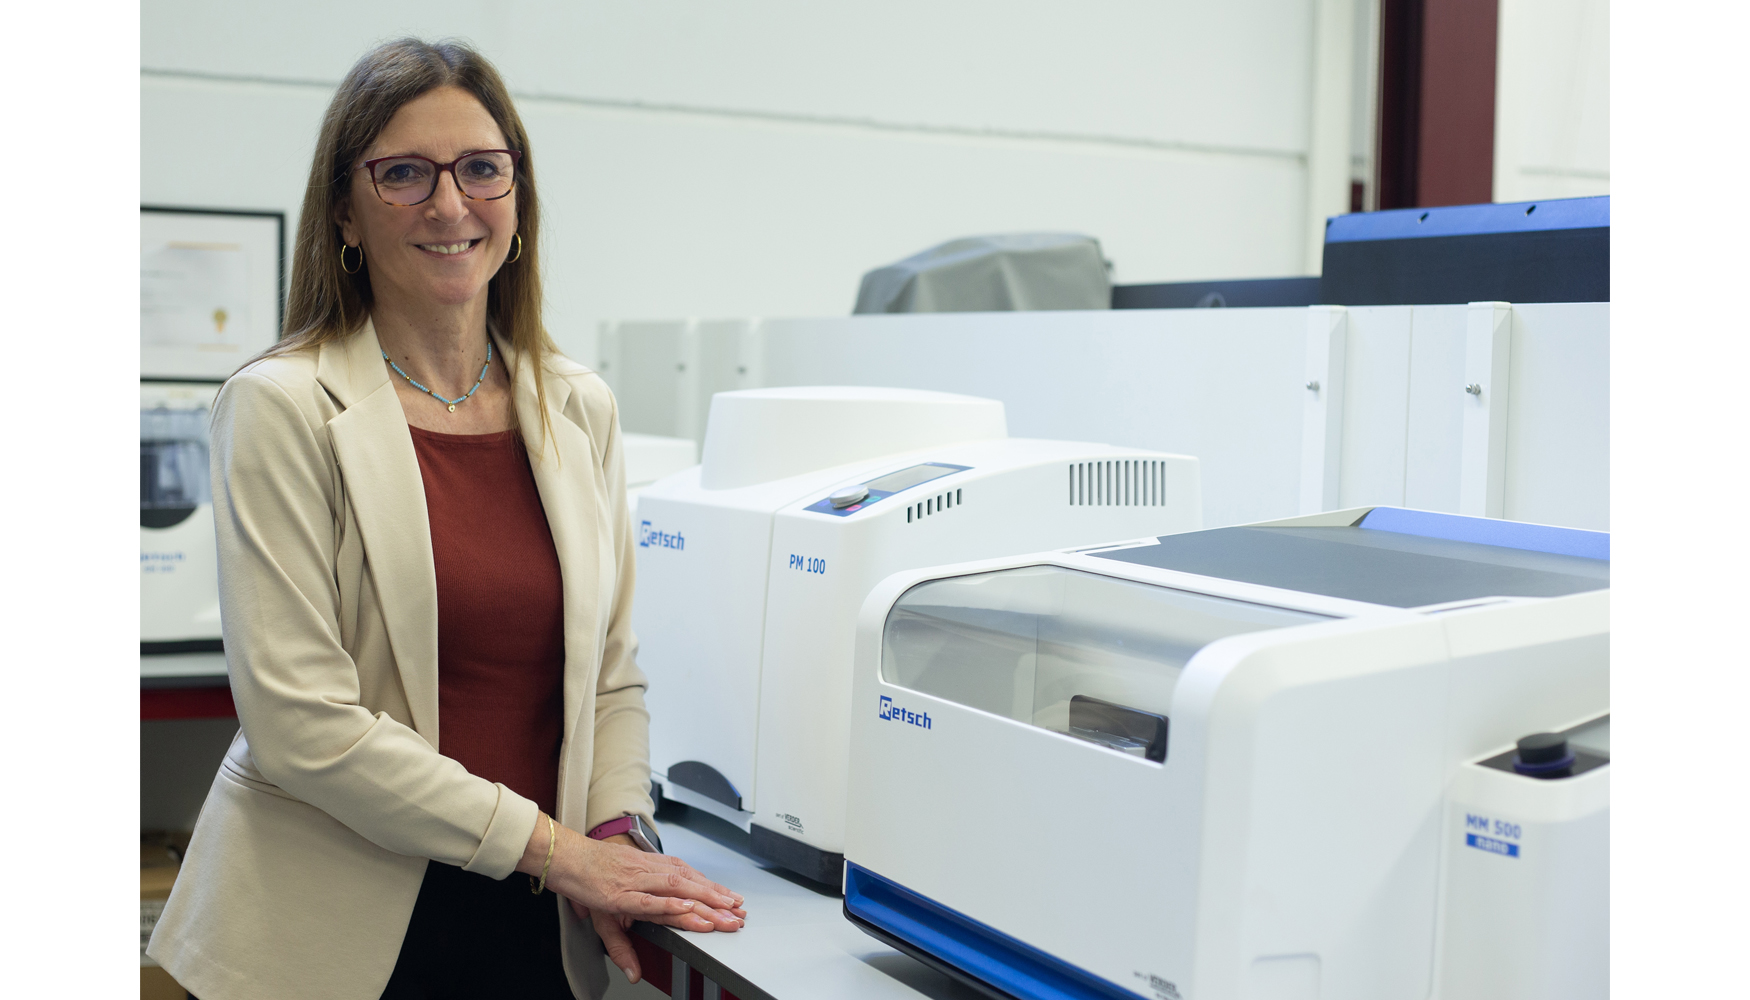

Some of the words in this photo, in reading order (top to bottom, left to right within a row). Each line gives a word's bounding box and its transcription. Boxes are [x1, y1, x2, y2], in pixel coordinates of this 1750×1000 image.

[640, 520, 685, 551] Retsch
[789, 554, 804, 571] PM
[807, 556, 826, 575] 100
[879, 694, 932, 730] Retsch
[1466, 812, 1489, 833] MM
[1494, 819, 1522, 840] 500
[1476, 836, 1509, 856] nano
